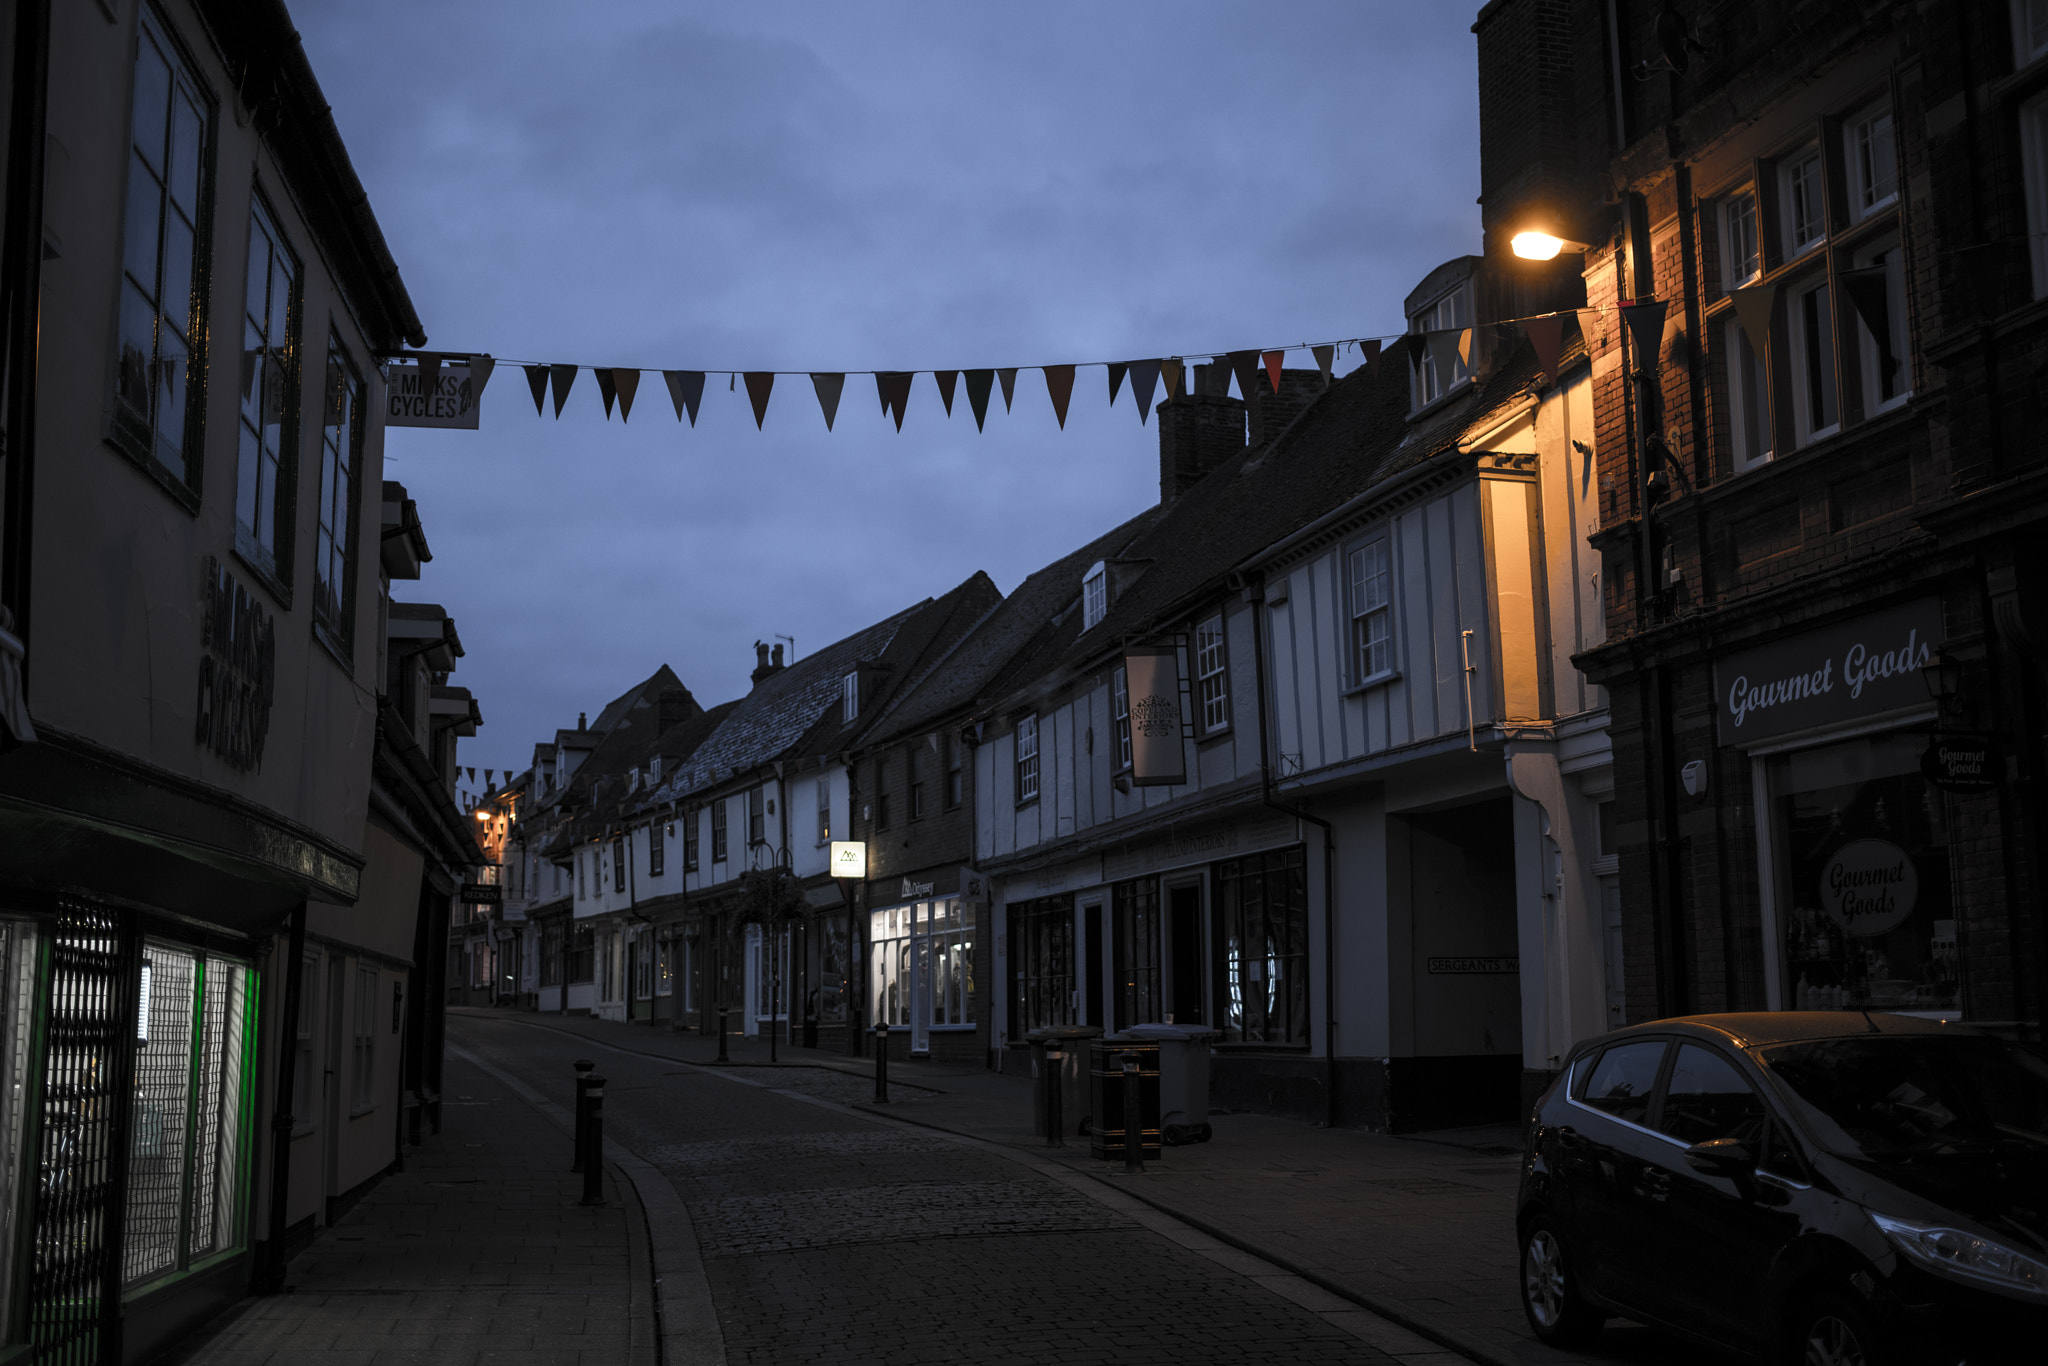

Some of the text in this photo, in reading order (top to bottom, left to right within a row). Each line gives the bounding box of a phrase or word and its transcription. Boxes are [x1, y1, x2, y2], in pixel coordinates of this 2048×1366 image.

[401, 374, 458, 396] MIKS
[390, 395, 457, 419] CYCLES
[1728, 628, 1930, 728] Gourmet Goods
[1131, 706, 1178, 715] COPELAND
[1132, 712, 1179, 720] INTERIORS
[1938, 746, 1986, 764] Gourmet
[1947, 760, 1981, 777] Goods
[1829, 859, 1904, 898] Gourmet
[464, 890, 498, 900] REDKEN
[1842, 887, 1895, 925] Goods
[1432, 959, 1501, 971] SERGEANTS
